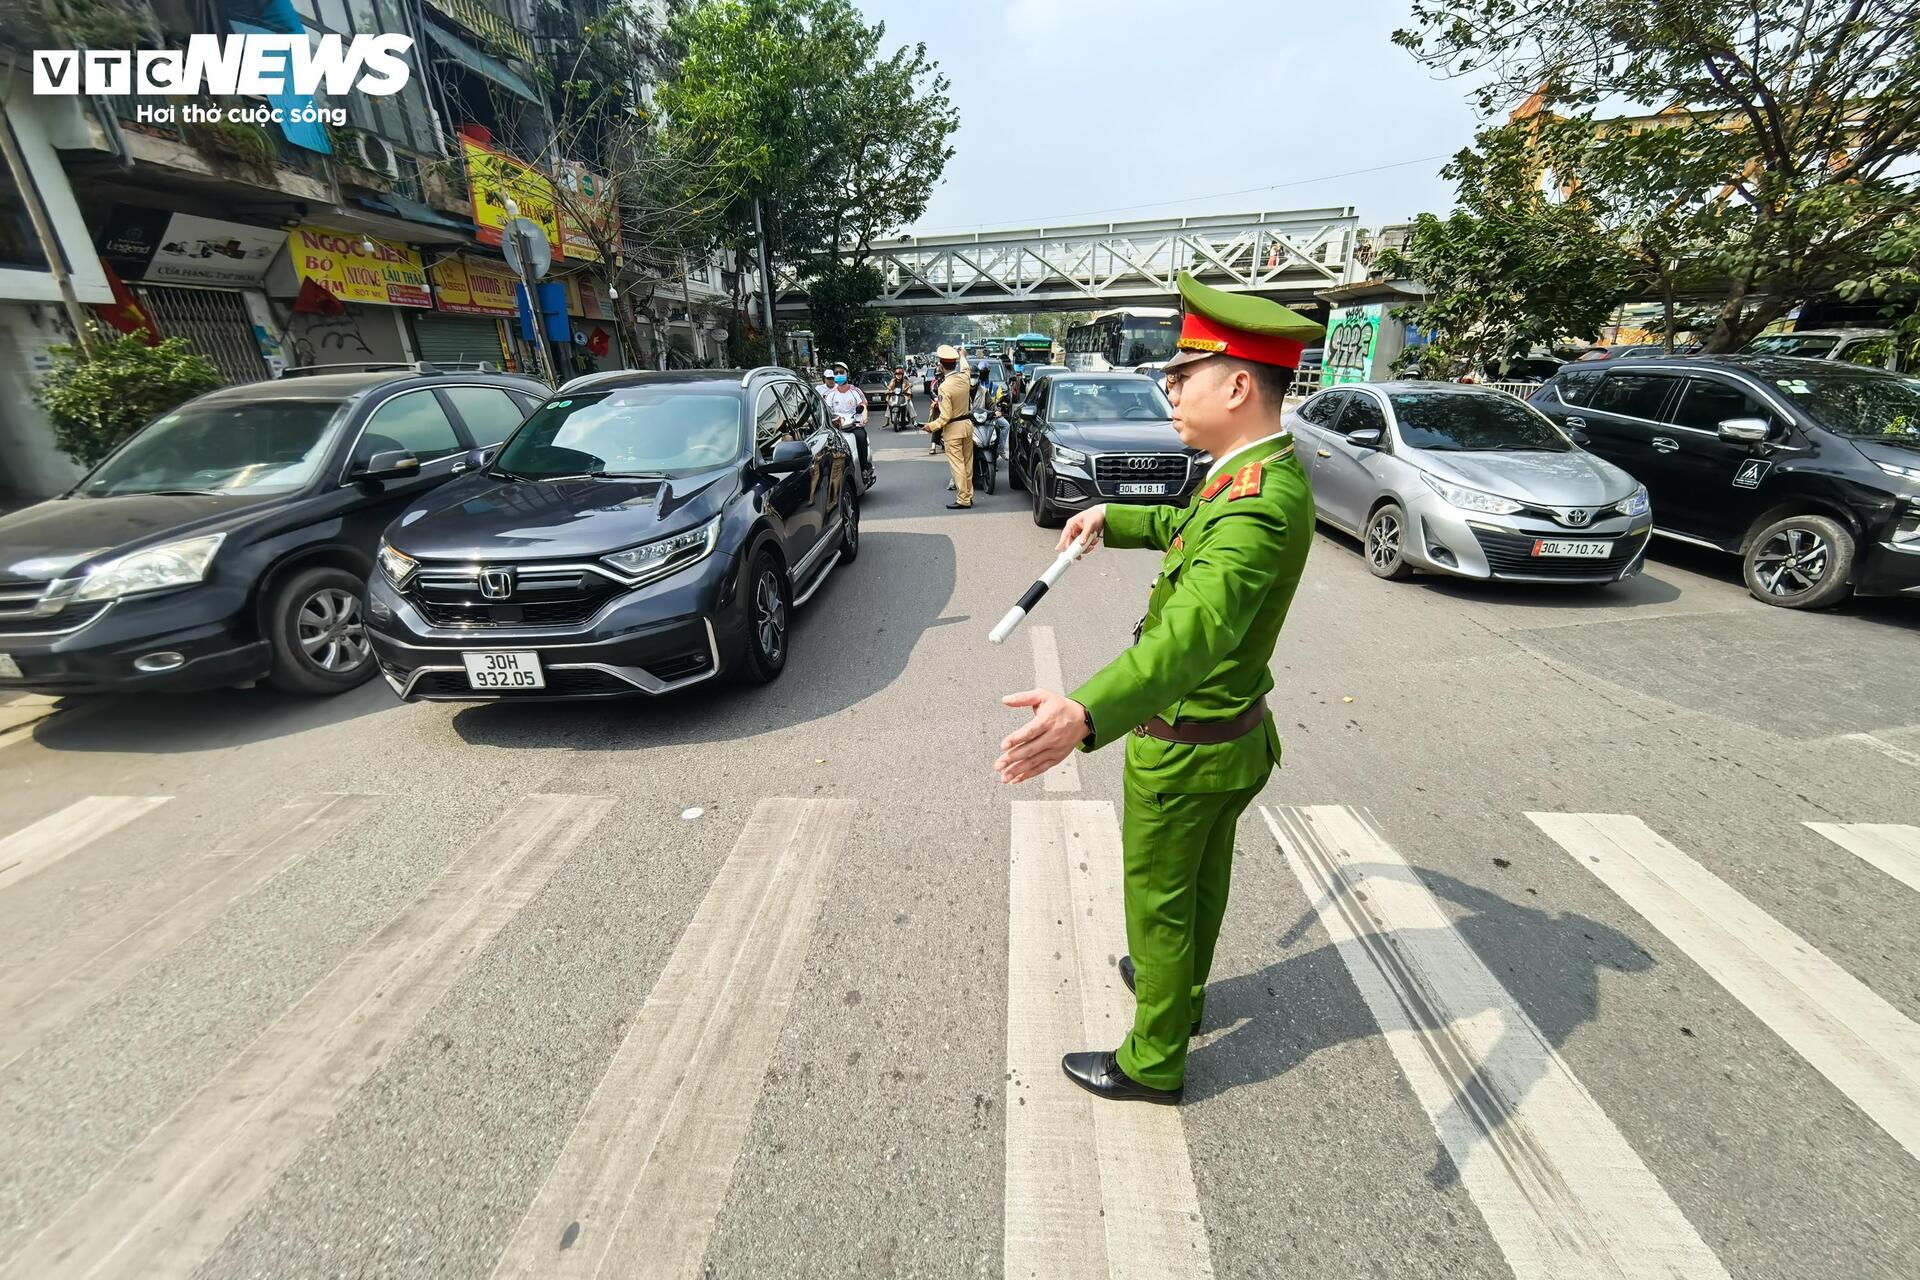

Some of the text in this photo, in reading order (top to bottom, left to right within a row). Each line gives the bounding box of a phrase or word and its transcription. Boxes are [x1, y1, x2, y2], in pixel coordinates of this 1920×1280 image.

[300, 230, 366, 259] NGỌC
[305, 256, 333, 271] BÒ
[1120, 485, 1164, 493] 30L-118.11
[1541, 543, 1605, 555] 30L-710.74
[484, 654, 518, 669] 30H
[476, 671, 535, 686] 932.05
